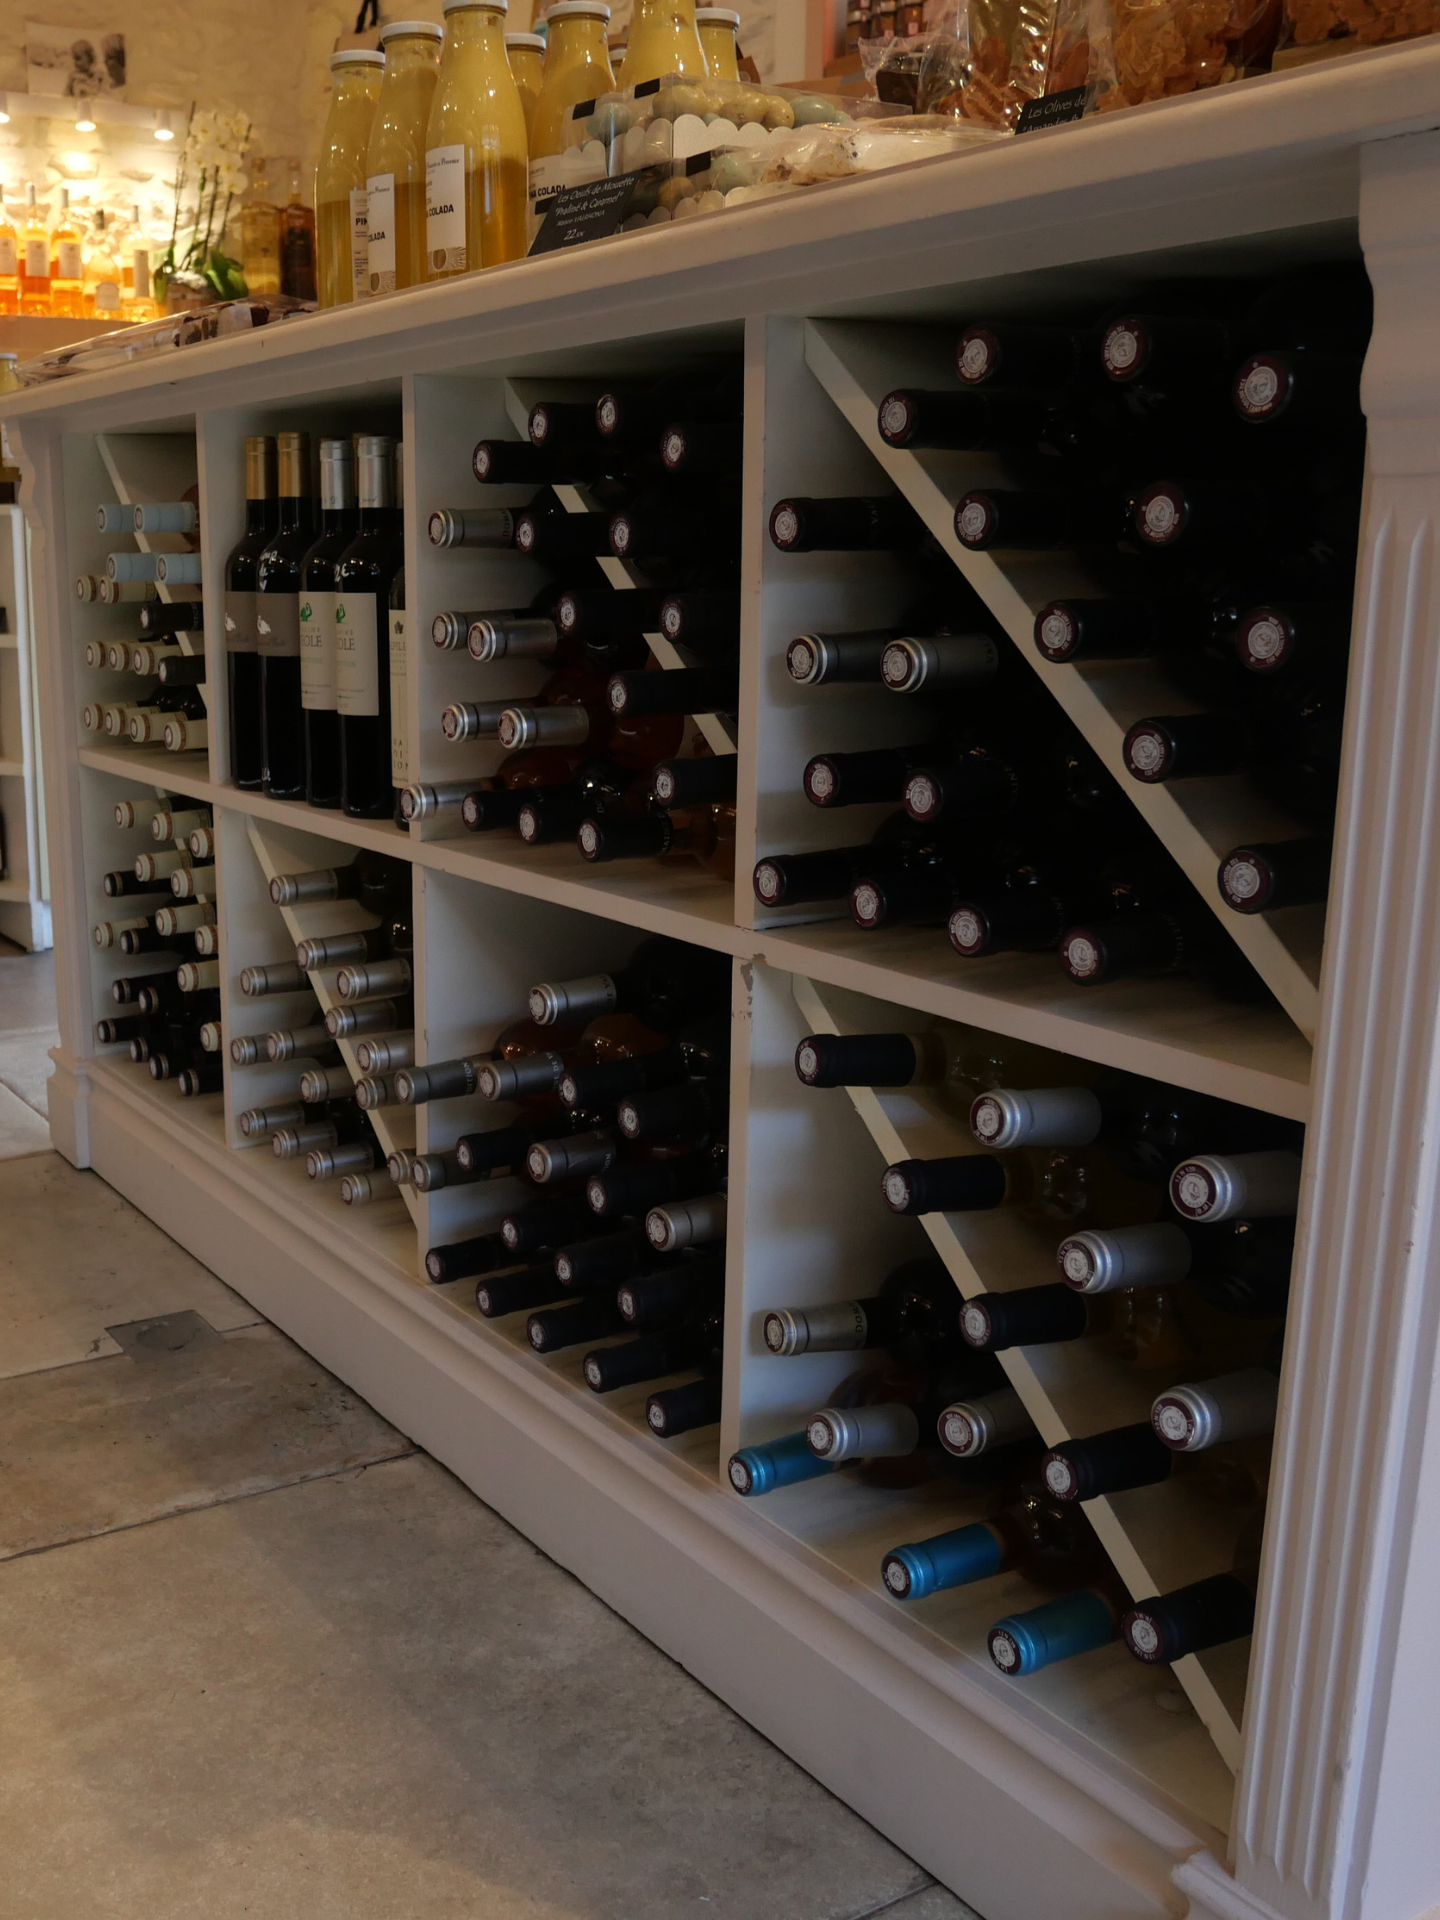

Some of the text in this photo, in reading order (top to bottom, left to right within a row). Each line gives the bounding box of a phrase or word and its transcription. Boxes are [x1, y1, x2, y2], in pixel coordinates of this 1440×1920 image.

[1027, 107, 1042, 119] Les
[1044, 100, 1073, 115] Olives
[557, 194, 570, 204] Les
[591, 184, 601, 196] de
[601, 176, 635, 192] Mouette
[428, 204, 455, 217] COLADA
